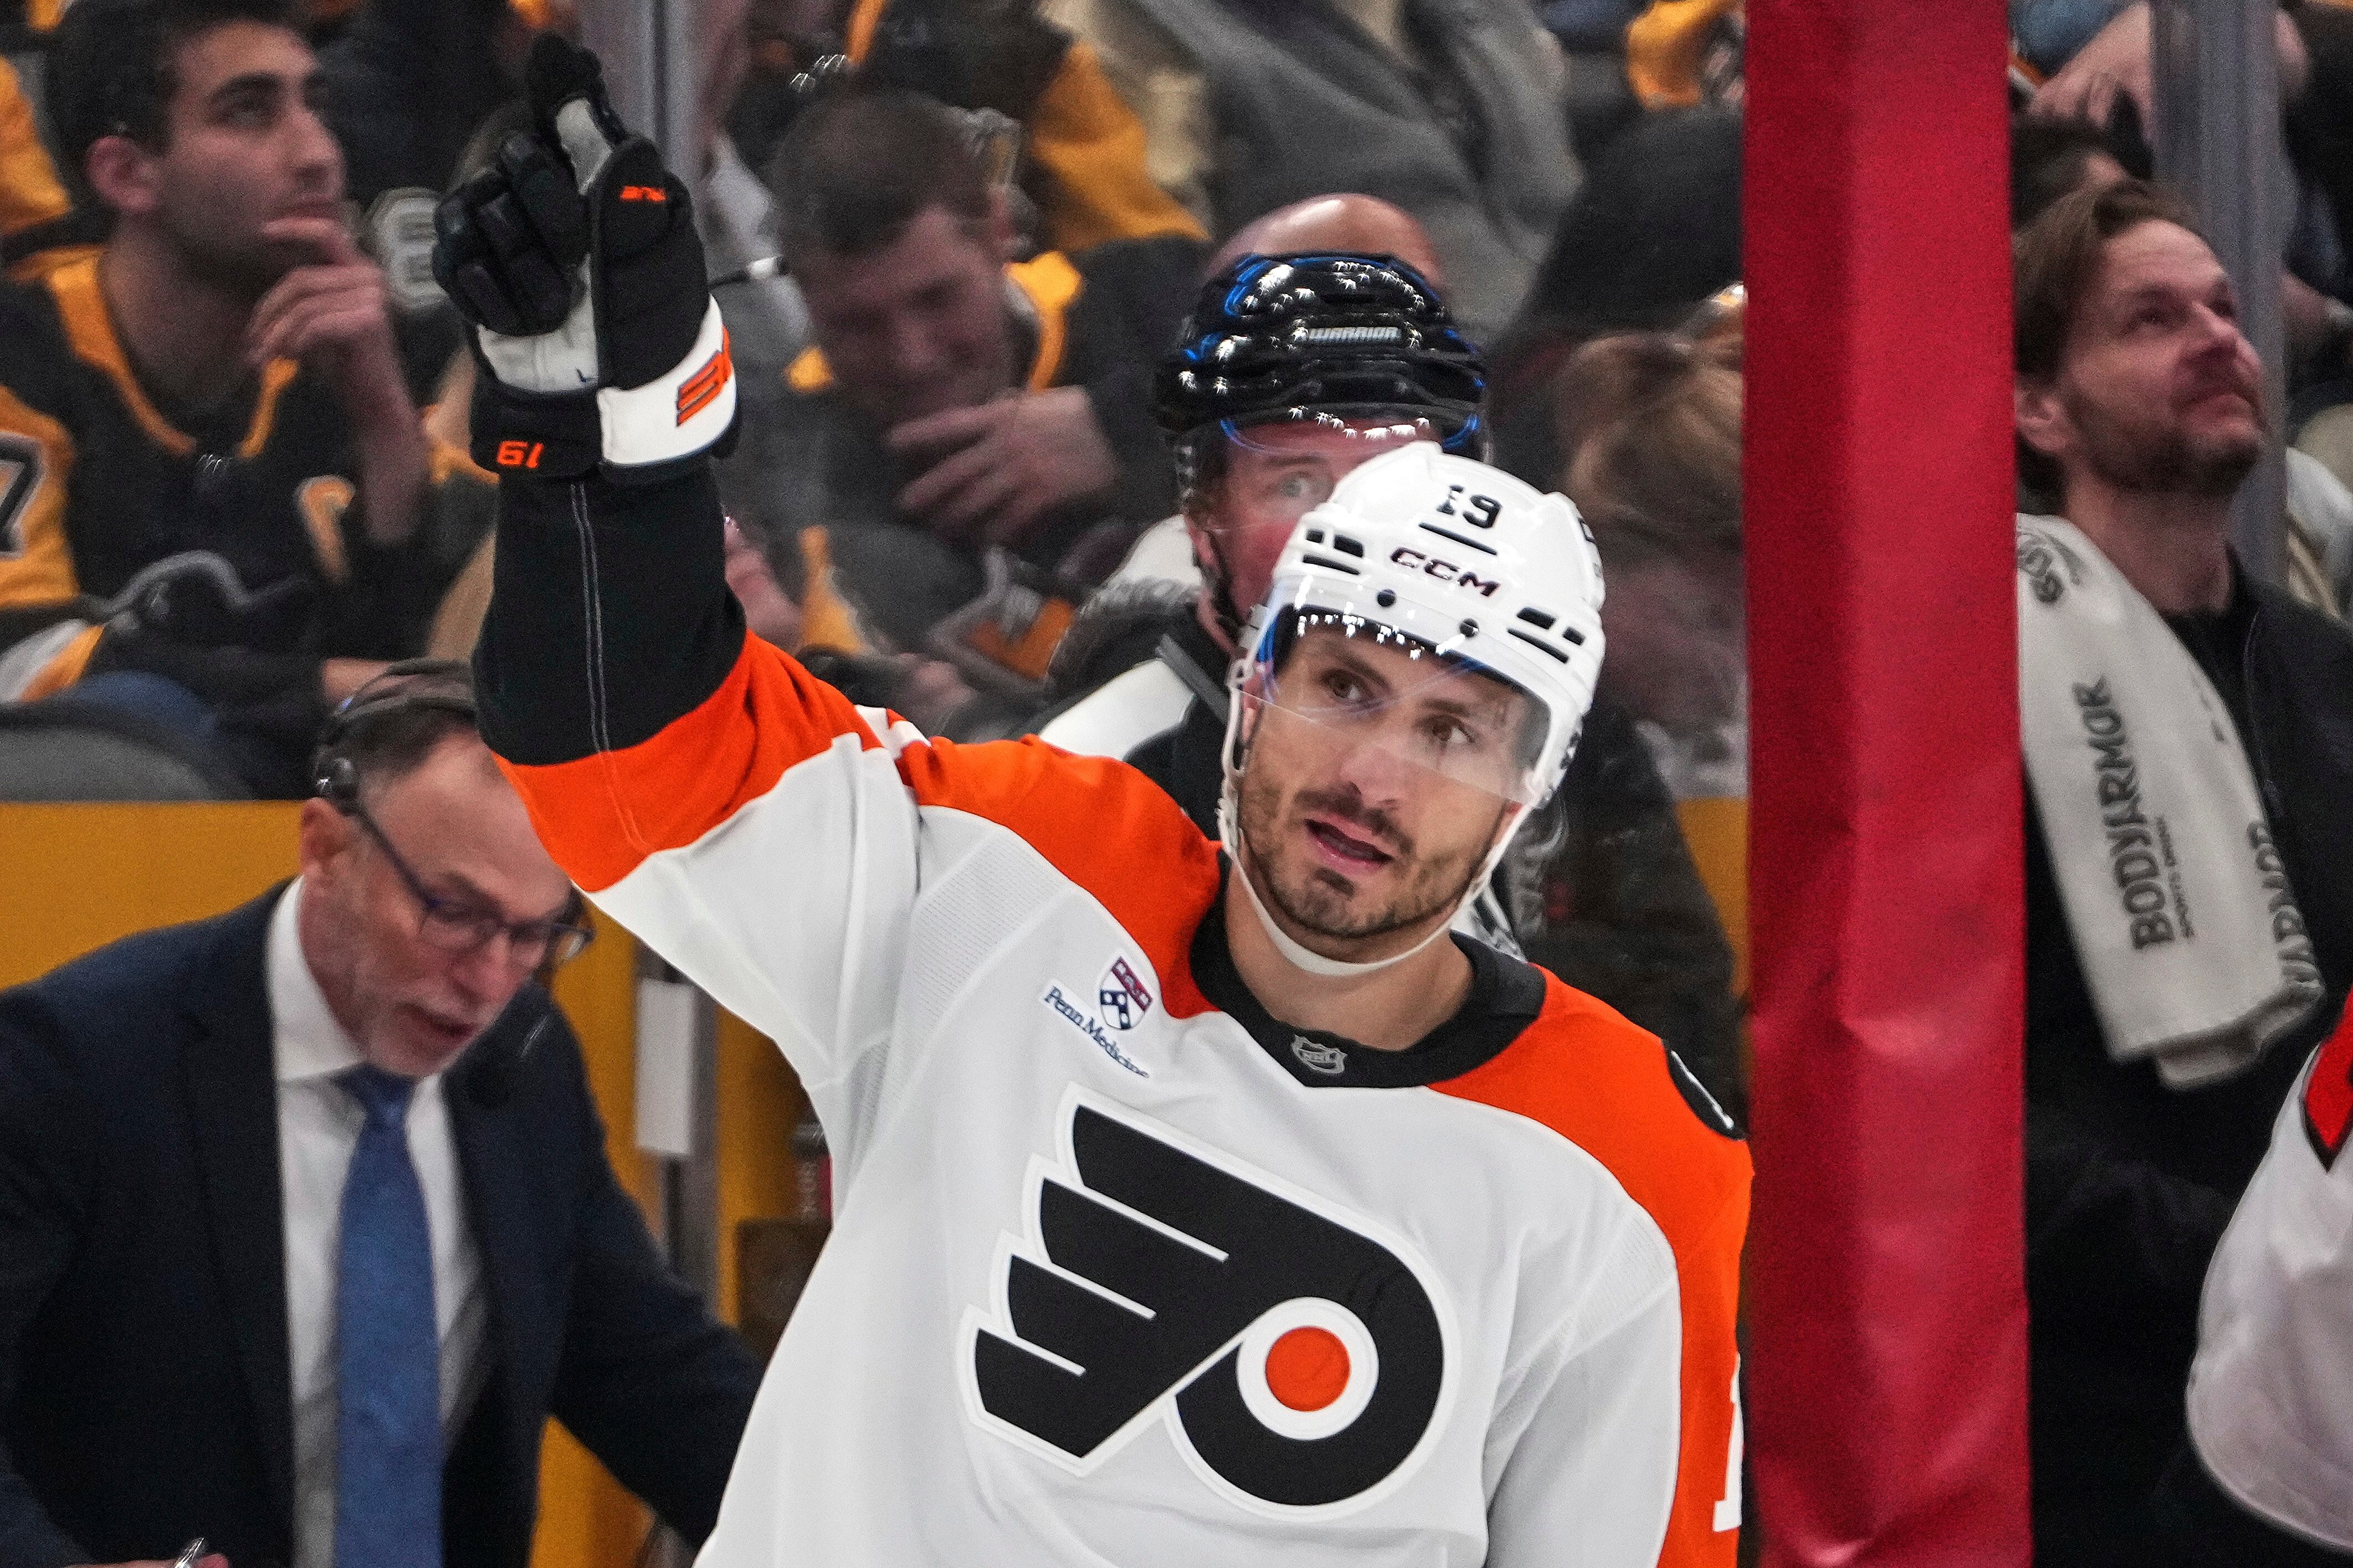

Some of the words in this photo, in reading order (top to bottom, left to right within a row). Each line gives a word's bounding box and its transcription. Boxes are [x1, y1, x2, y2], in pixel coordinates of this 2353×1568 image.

[1390, 546, 1501, 598] CCM
[2072, 675, 2176, 951] BODYARMOR
[1044, 985, 1084, 1026] Penn
[1082, 1016, 1150, 1079] Medicine
